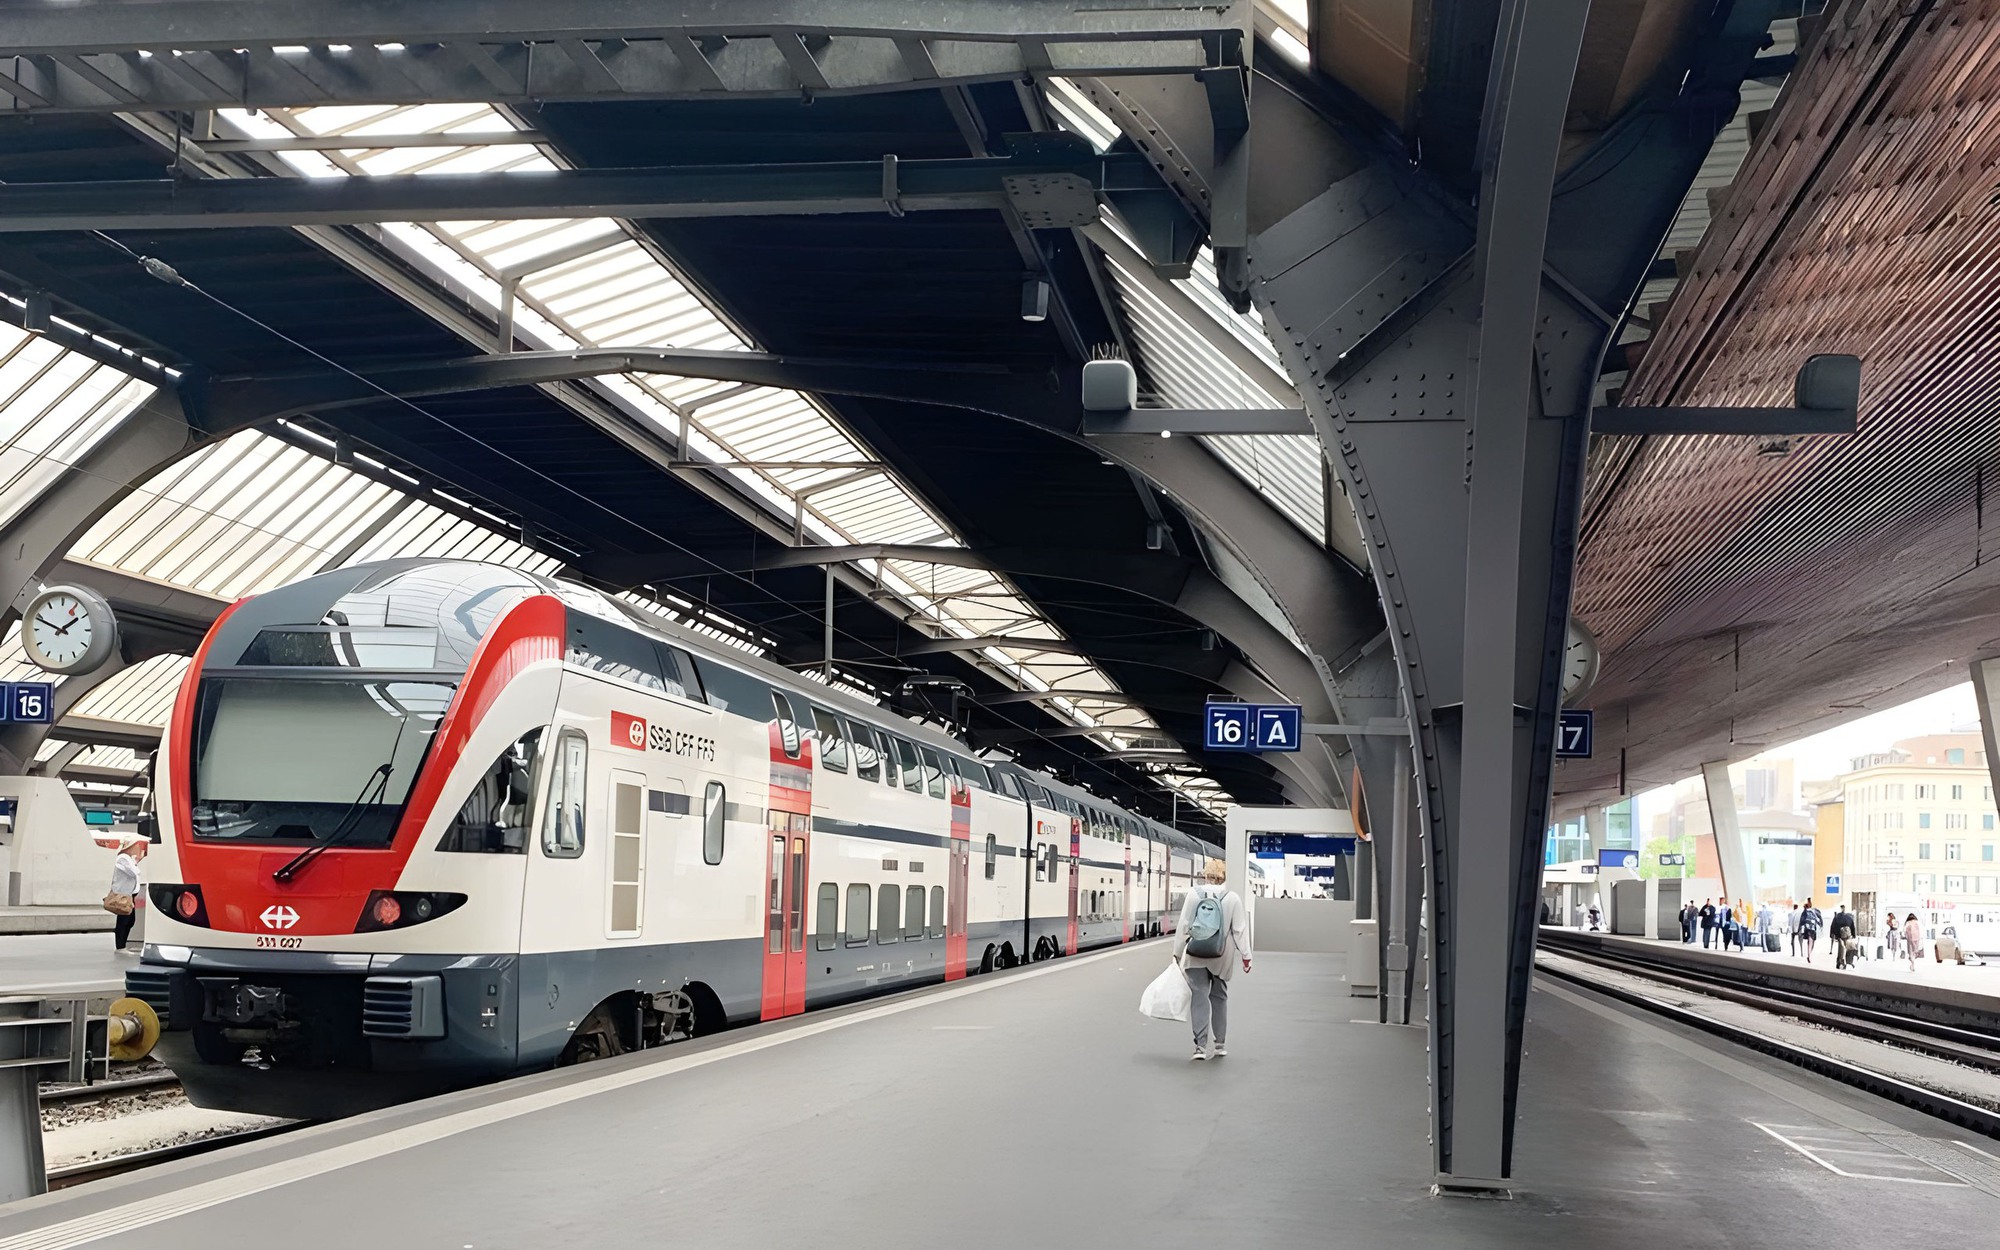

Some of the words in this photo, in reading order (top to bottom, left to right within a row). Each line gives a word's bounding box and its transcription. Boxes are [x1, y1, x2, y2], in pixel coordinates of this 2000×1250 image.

[19, 695, 42, 717] 15
[1214, 719, 1241, 743] 16
[1267, 720, 1287, 743] A
[1557, 726, 1583, 750] 17
